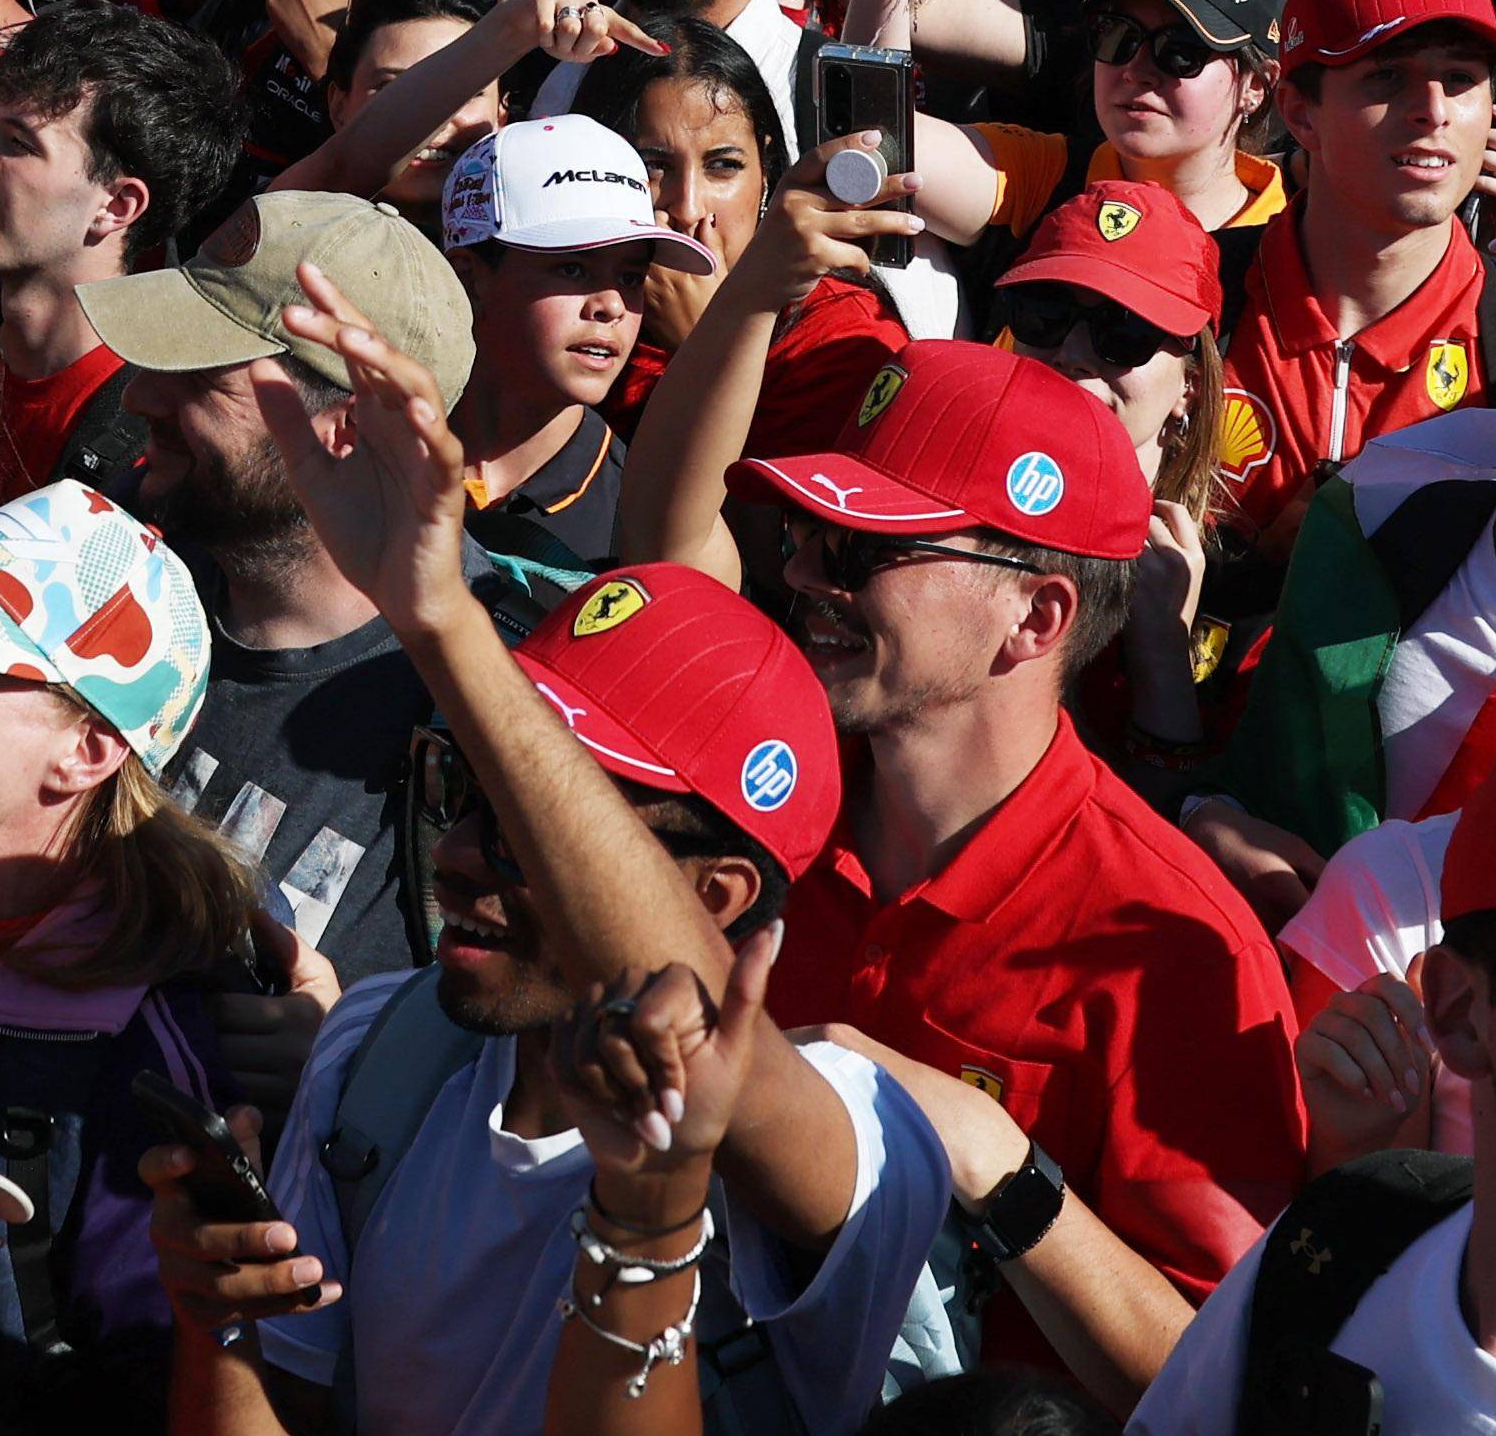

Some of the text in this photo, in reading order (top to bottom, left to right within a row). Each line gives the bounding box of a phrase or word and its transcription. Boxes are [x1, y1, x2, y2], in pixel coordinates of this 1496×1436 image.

[266, 79, 322, 124] ORACLE
[542, 169, 647, 195] McLaren
[1012, 454, 1062, 513] hp
[747, 742, 793, 807] hp
